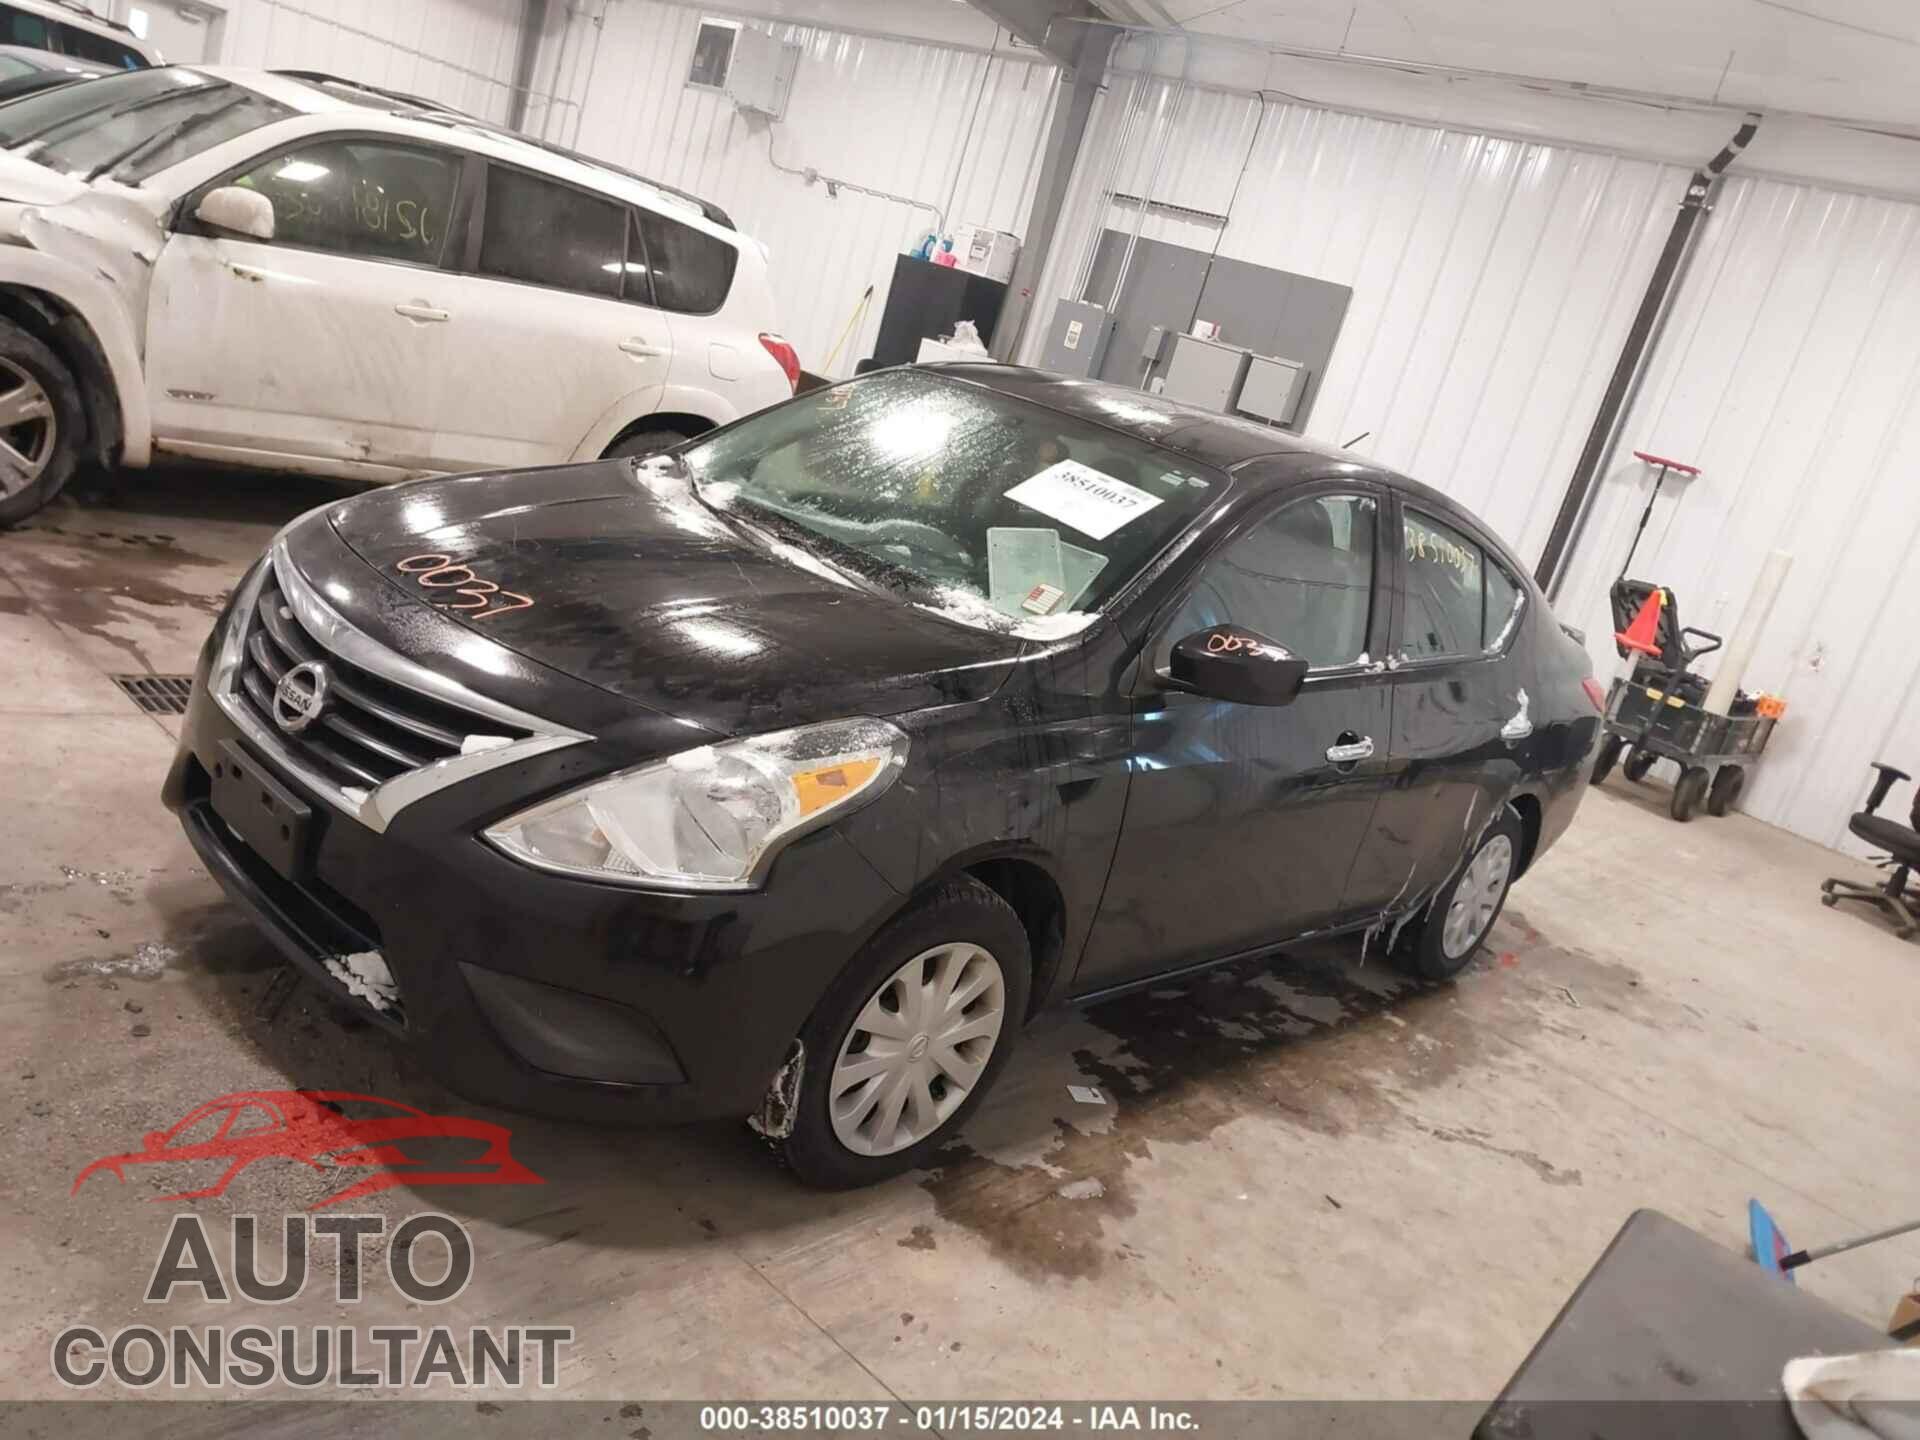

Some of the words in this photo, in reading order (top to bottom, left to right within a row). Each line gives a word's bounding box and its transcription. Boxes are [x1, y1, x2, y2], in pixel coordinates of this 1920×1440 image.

[1055, 471, 1138, 508] 38510037
[397, 554, 535, 619] 0037
[1208, 634, 1284, 661] 003
